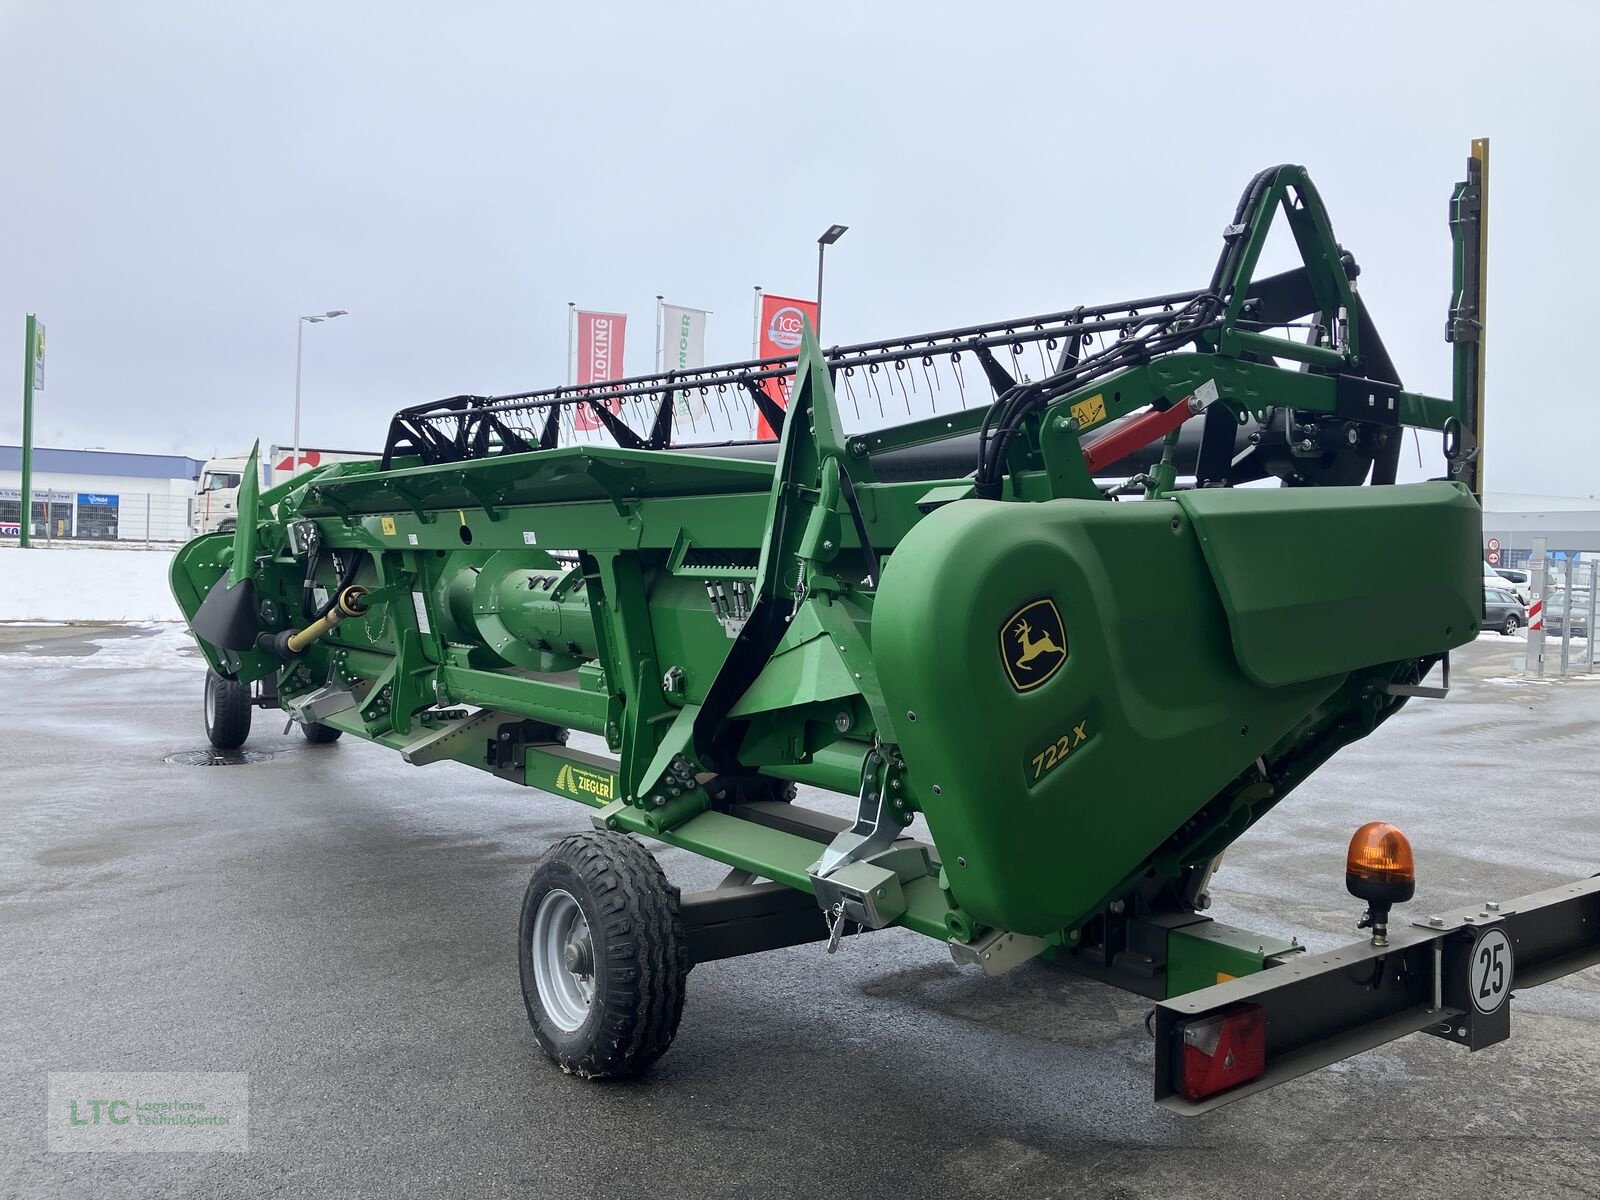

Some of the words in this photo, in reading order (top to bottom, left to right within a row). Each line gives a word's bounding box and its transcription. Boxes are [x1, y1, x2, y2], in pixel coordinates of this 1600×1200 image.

[1032, 735, 1069, 779] 722
[1073, 719, 1087, 748] X
[579, 776, 609, 798] ZIEGLER
[1480, 943, 1504, 999] 25
